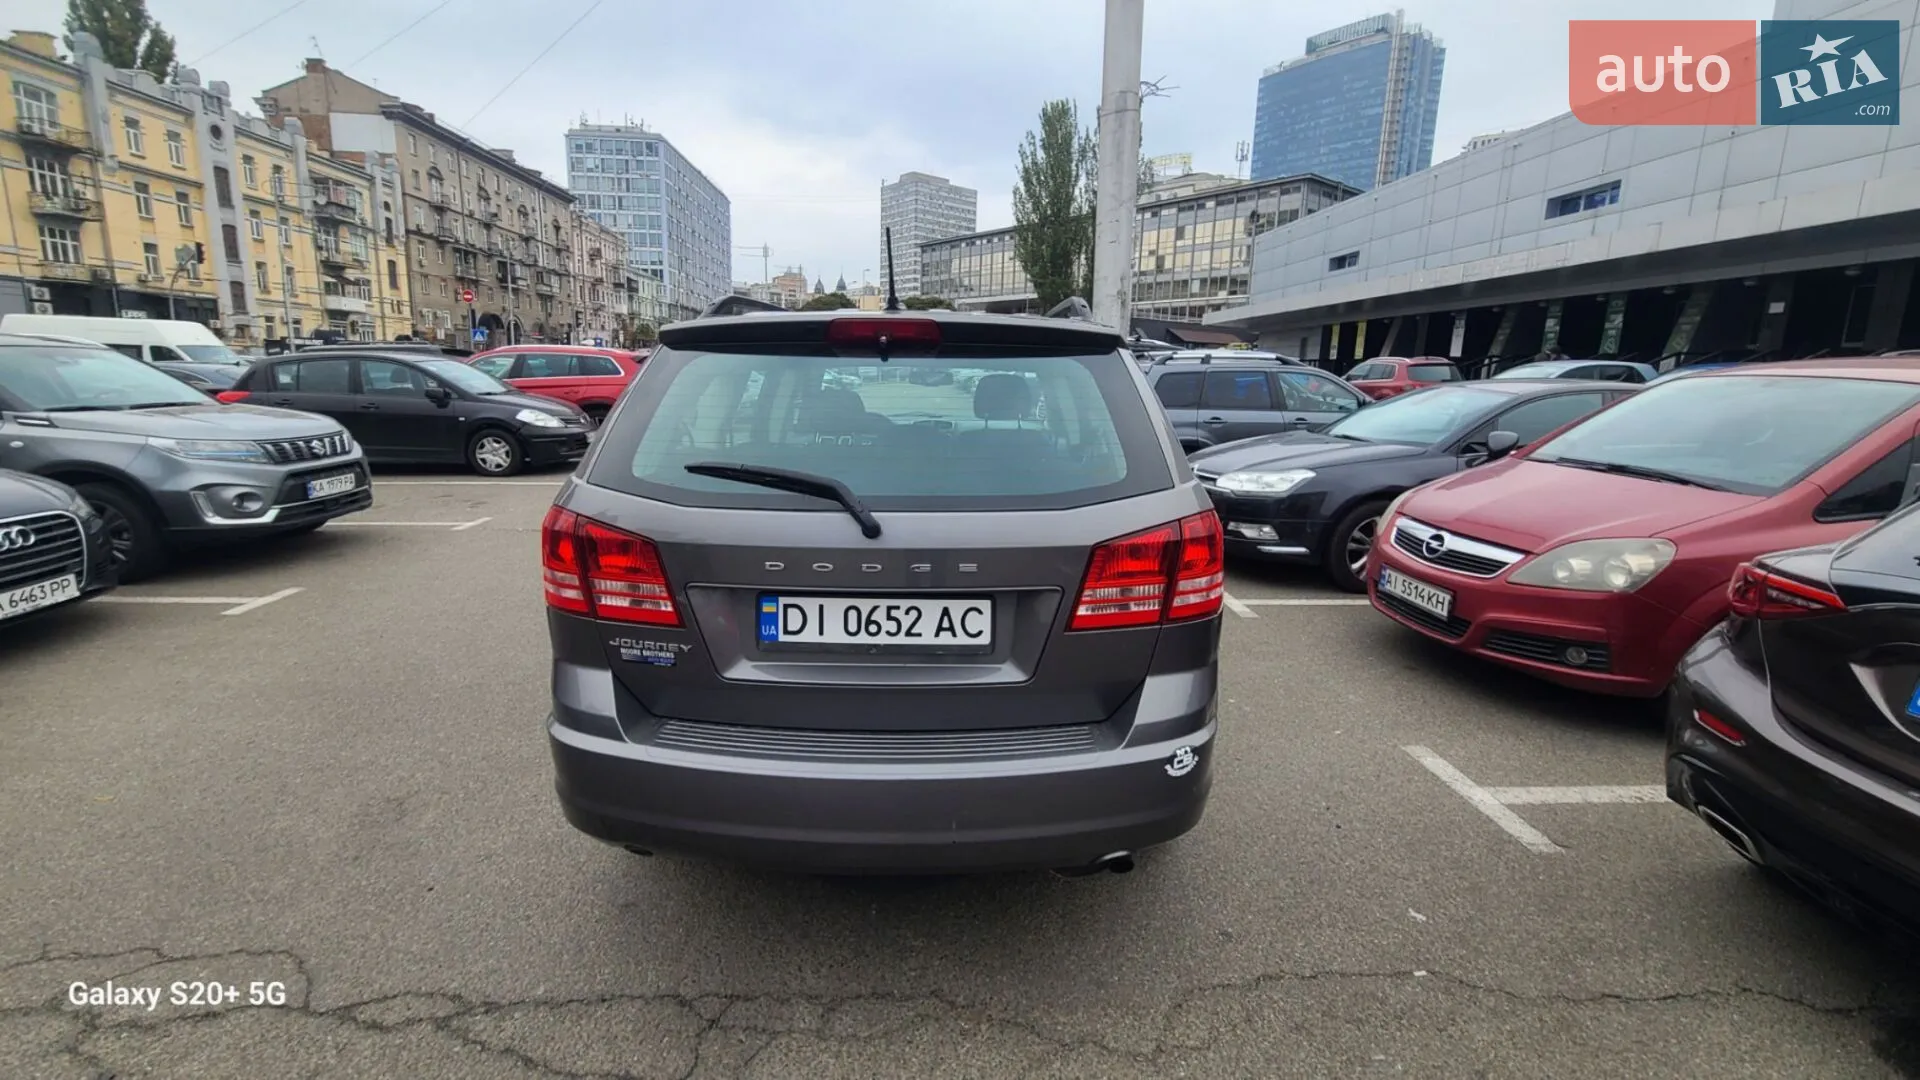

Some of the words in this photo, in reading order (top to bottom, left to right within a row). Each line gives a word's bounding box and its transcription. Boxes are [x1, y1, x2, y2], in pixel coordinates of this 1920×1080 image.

[764, 561, 978, 573] DODGE
[9, 585, 48, 608] 6463
[49, 578, 71, 597] PP
[1386, 573, 1398, 590] AI
[1401, 580, 1425, 604] 5514
[1426, 590, 1446, 612] KH
[782, 603, 824, 636] DI
[843, 604, 923, 637] 0652
[934, 606, 985, 639] AC
[762, 625, 777, 636] UA
[609, 637, 693, 653] JOURNEY
[642, 649, 675, 659] BROTHERS
